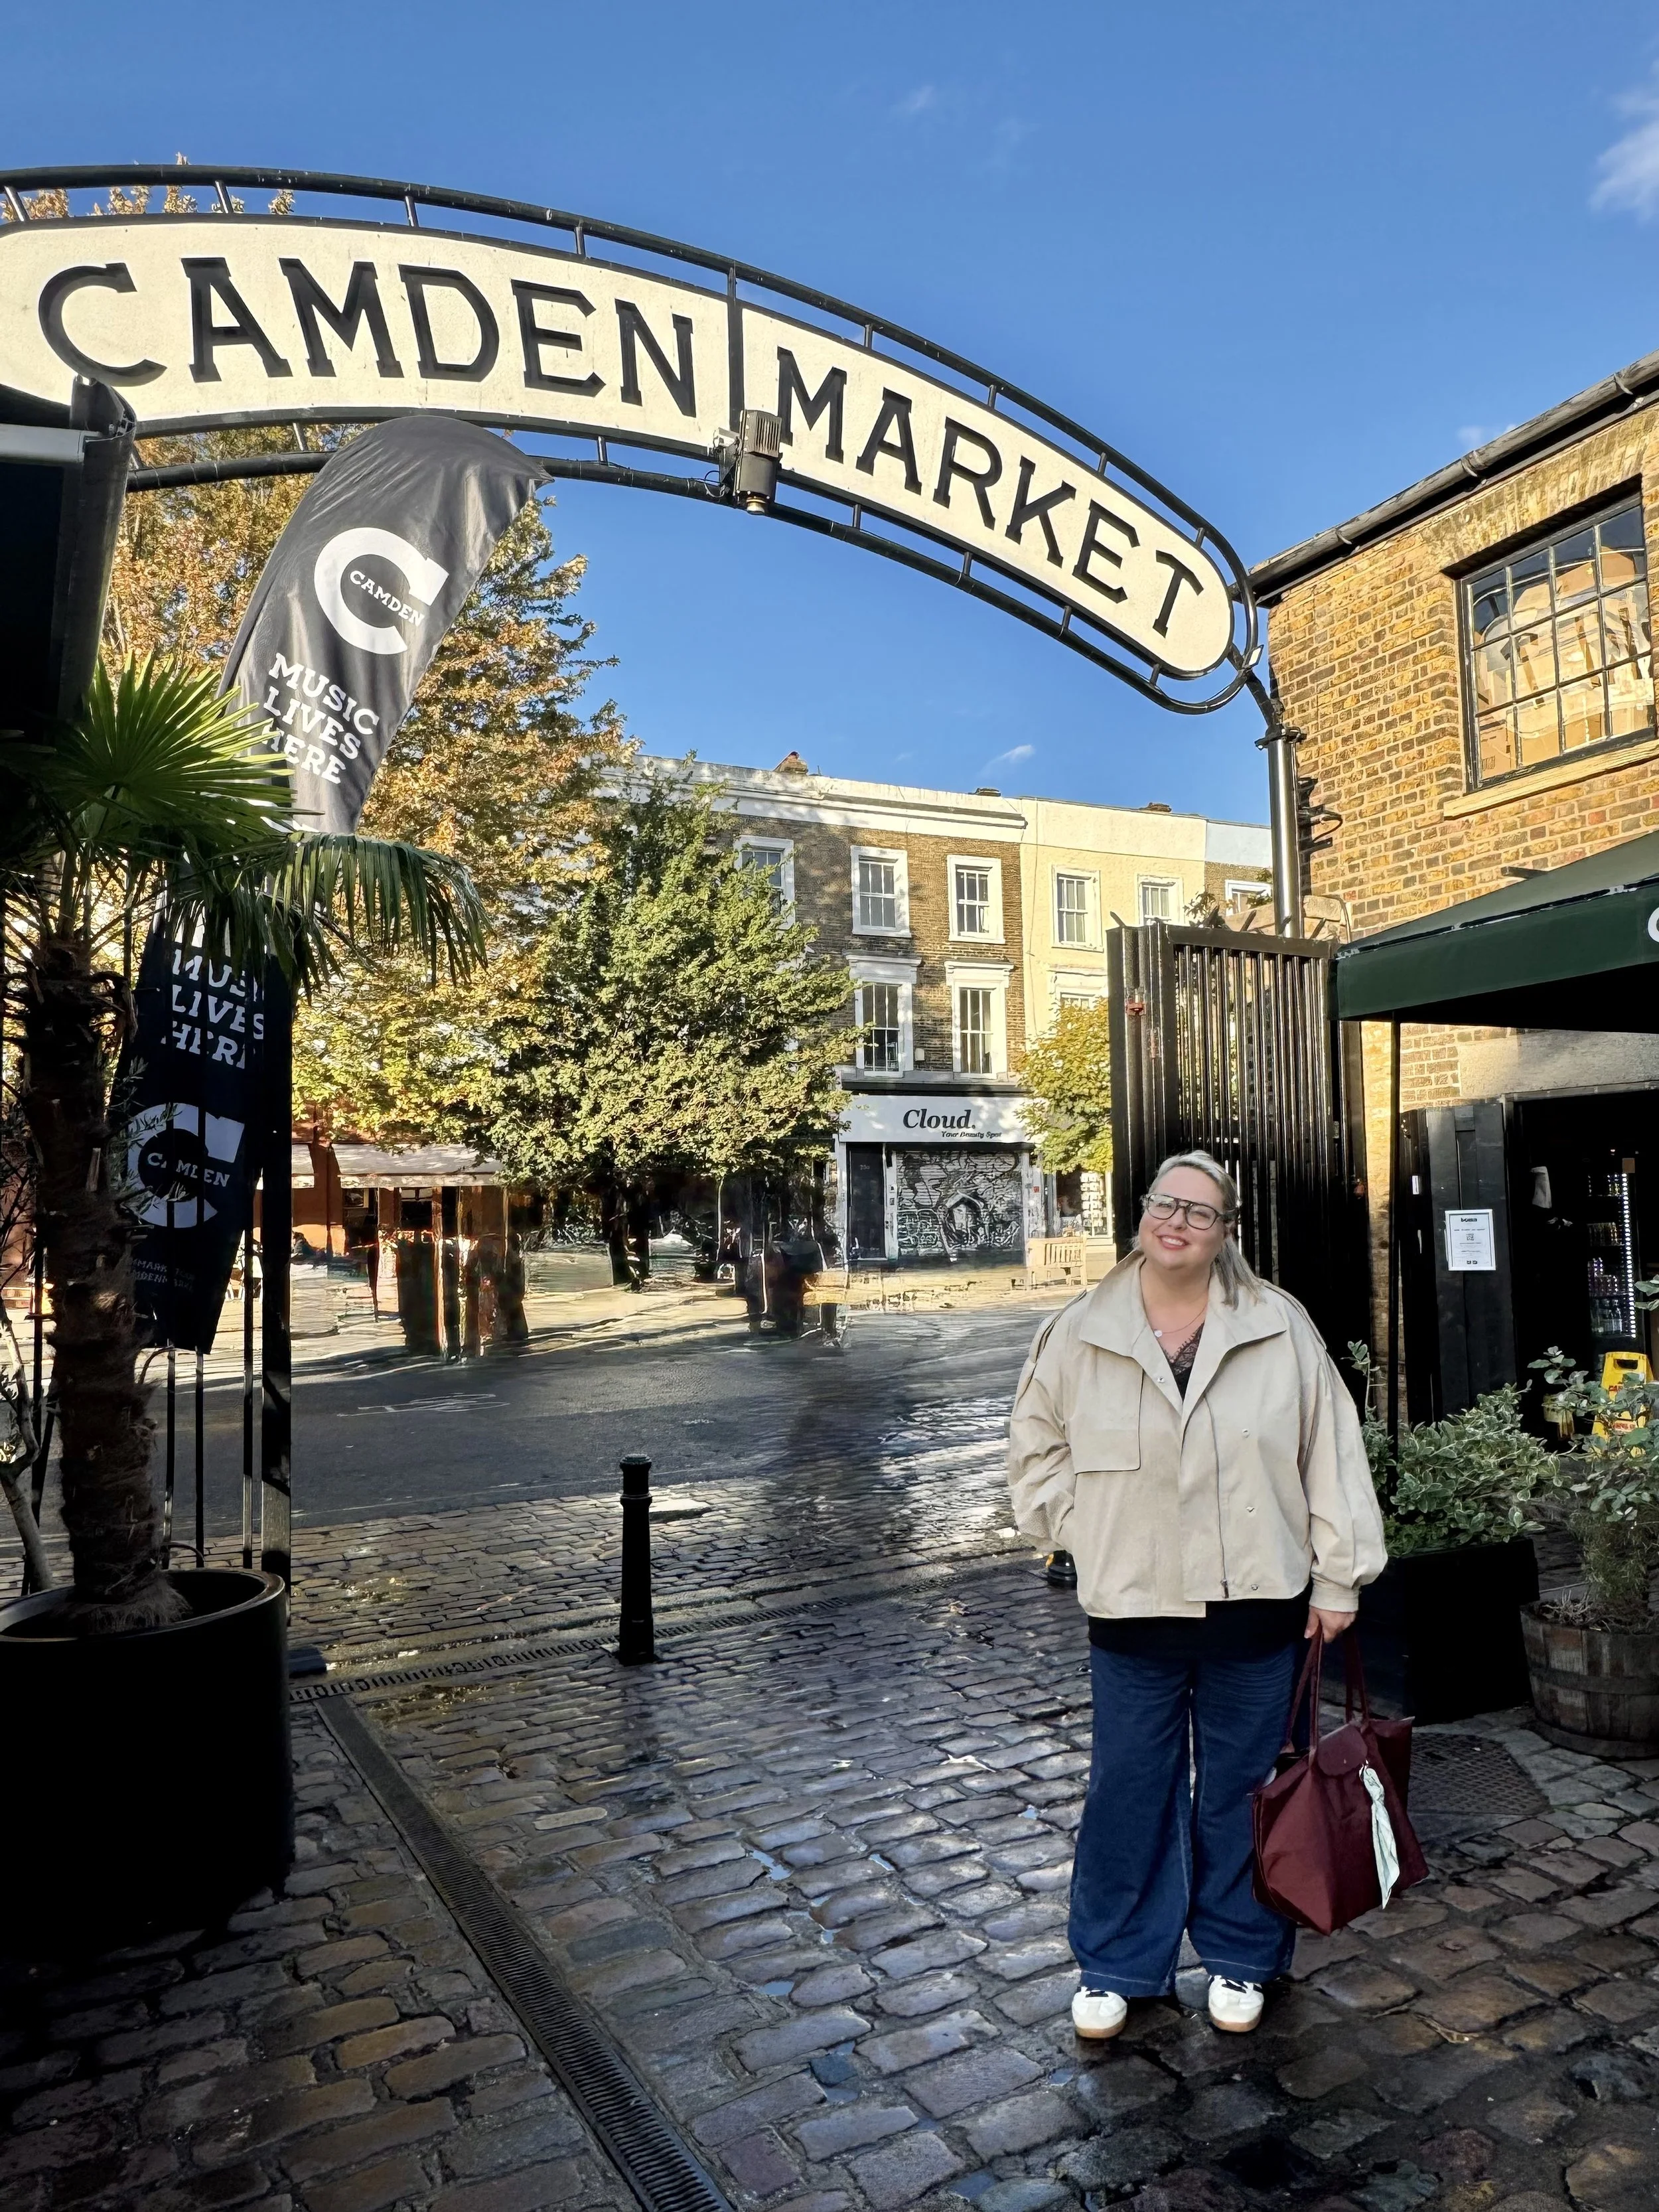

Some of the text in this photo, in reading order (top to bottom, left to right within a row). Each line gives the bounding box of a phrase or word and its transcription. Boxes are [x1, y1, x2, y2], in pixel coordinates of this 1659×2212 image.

[38, 257, 1204, 638] CAMDEN MARKET
[349, 570, 425, 627] CAMDEN
[263, 686, 361, 760] LIVES
[268, 652, 380, 735] MUSIC
[172, 984, 265, 1040] LIVES
[903, 1108, 976, 1130] Cloud.
